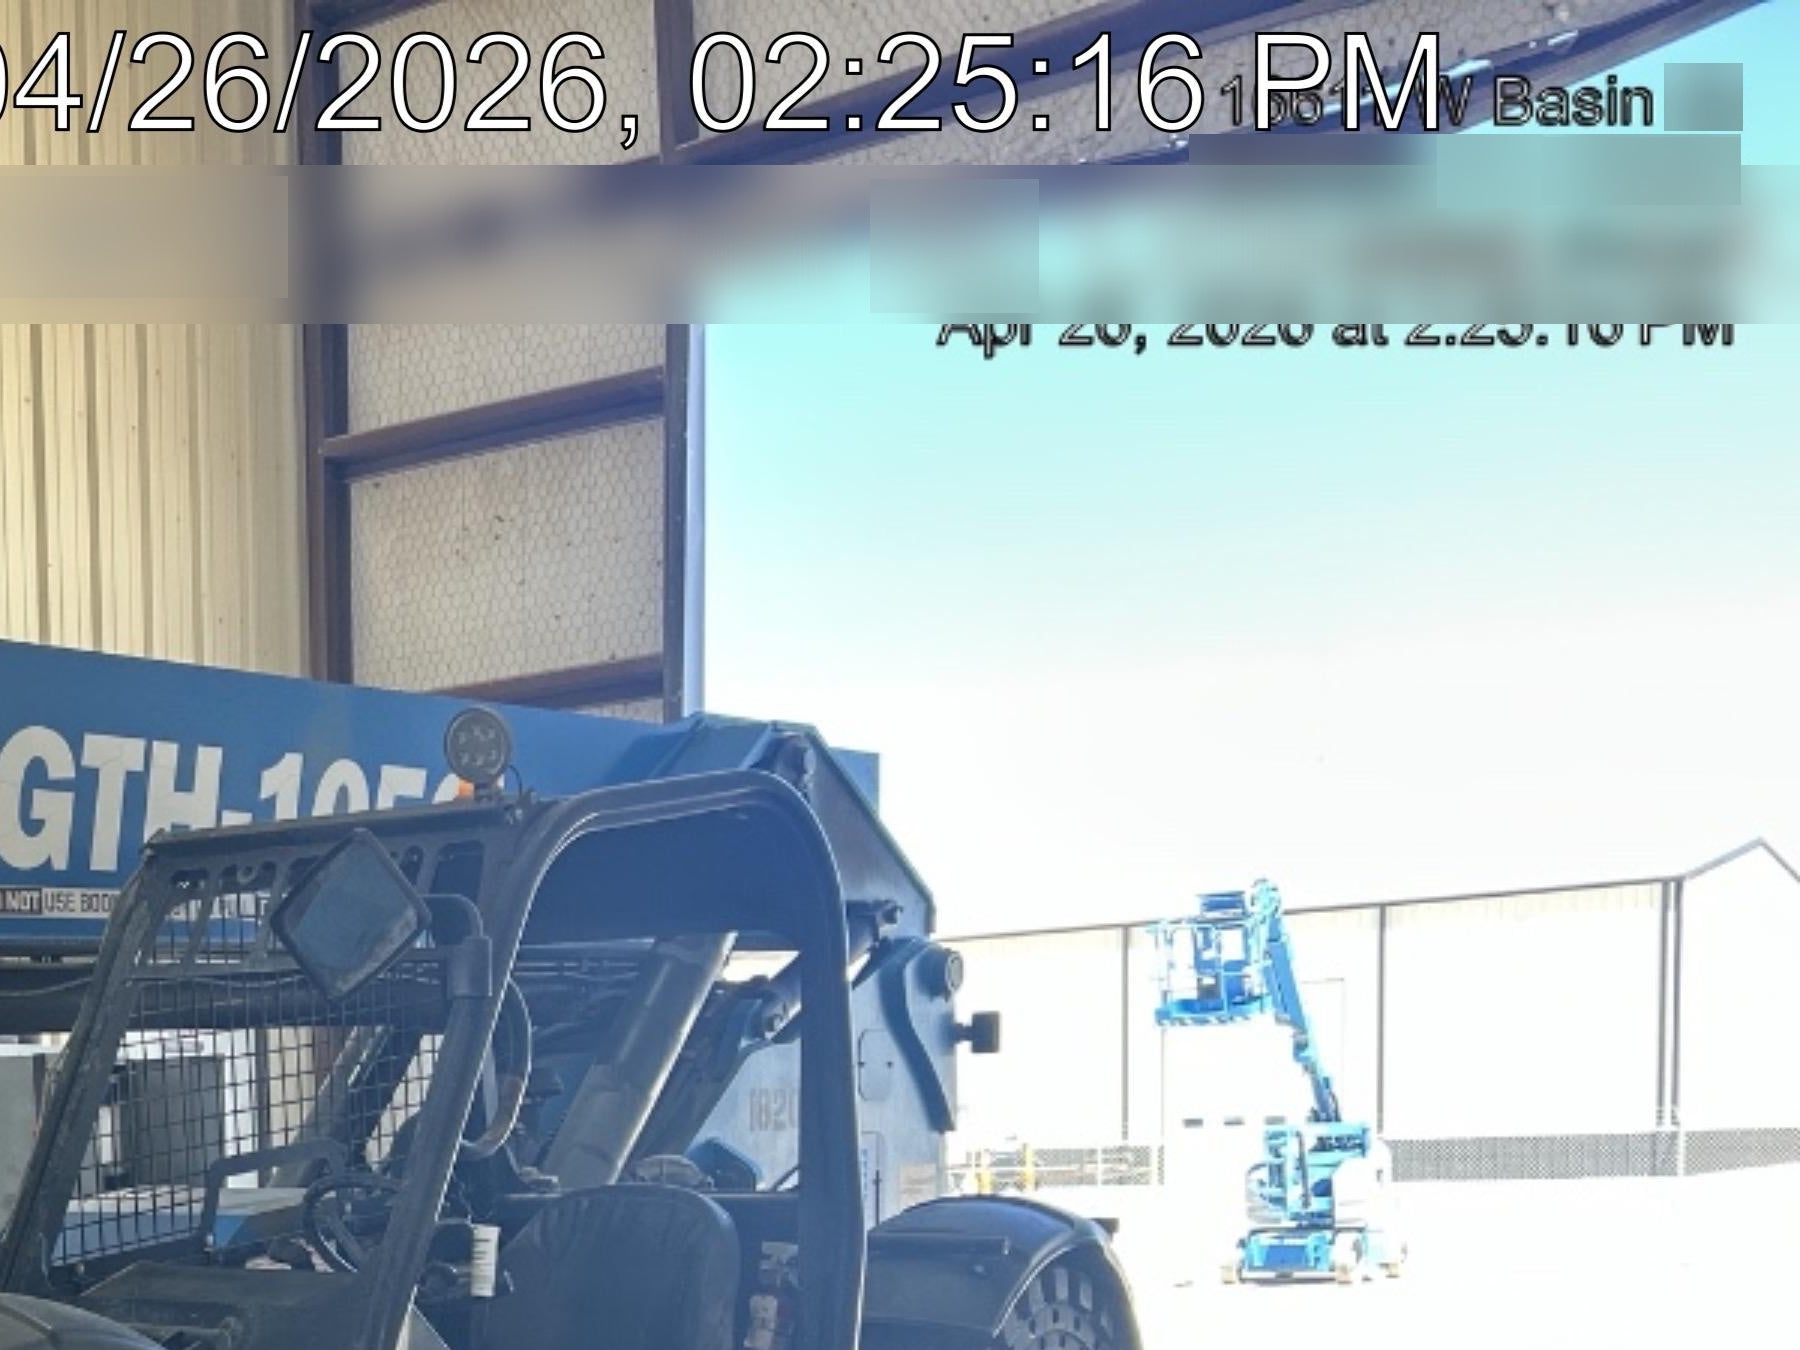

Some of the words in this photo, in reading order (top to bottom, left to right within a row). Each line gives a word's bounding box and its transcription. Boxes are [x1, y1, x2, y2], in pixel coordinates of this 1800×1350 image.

[5, 890, 41, 912] NOT
[43, 891, 77, 913] USE
[80, 892, 114, 914] BOO
